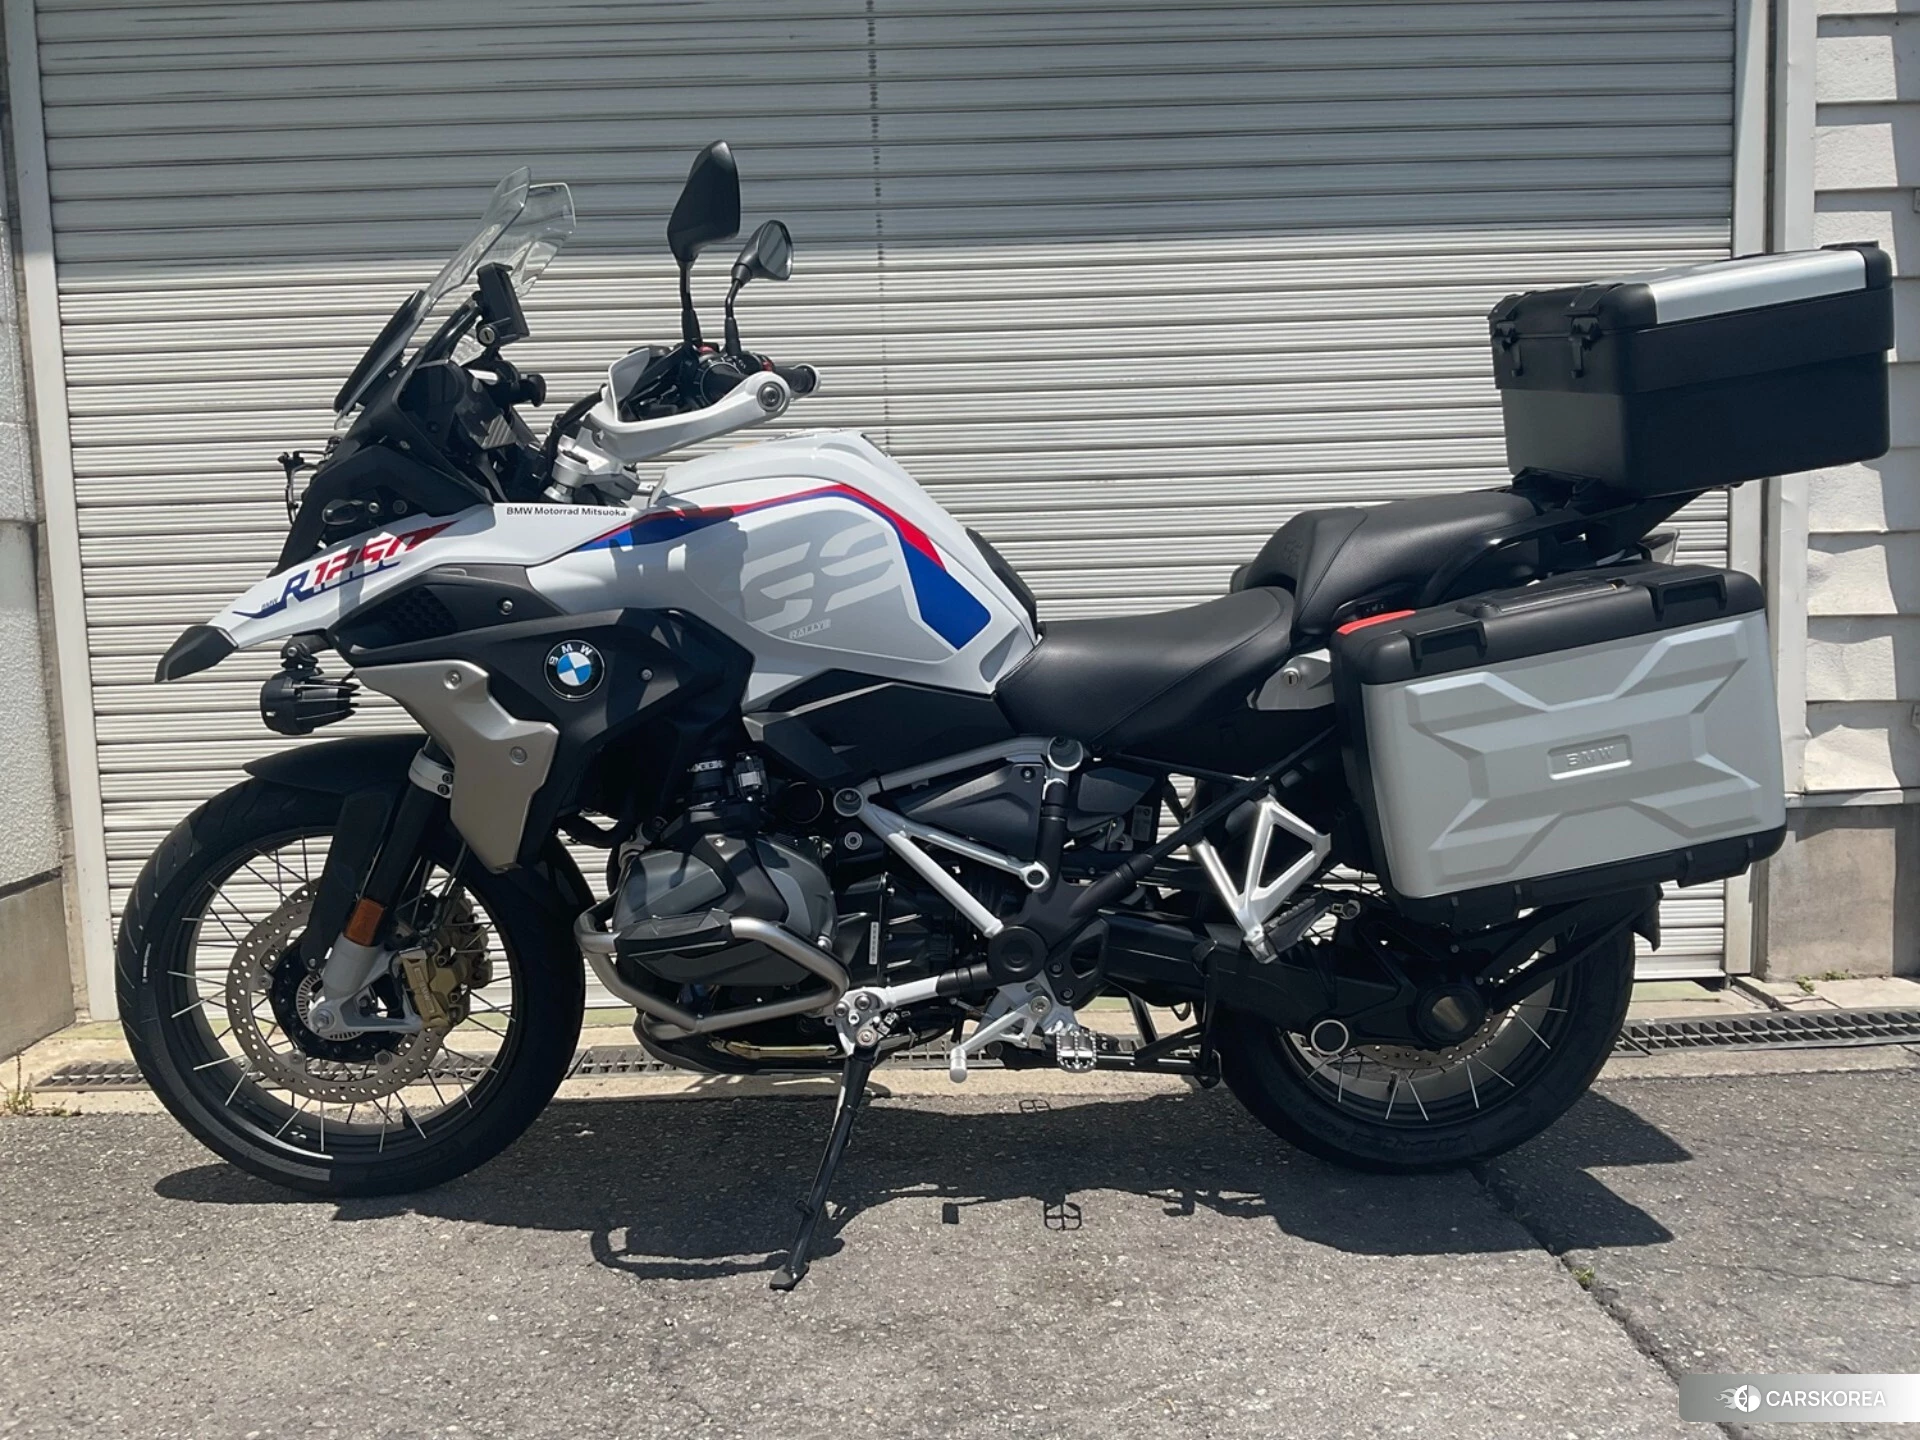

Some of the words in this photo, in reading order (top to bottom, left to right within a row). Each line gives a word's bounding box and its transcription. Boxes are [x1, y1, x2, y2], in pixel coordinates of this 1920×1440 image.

[506, 506, 533, 516] BMW
[535, 507, 580, 516] Motorrad
[581, 508, 627, 517] Mitsuoka
[548, 643, 593, 666] BMW
[1566, 745, 1615, 765] BMW
